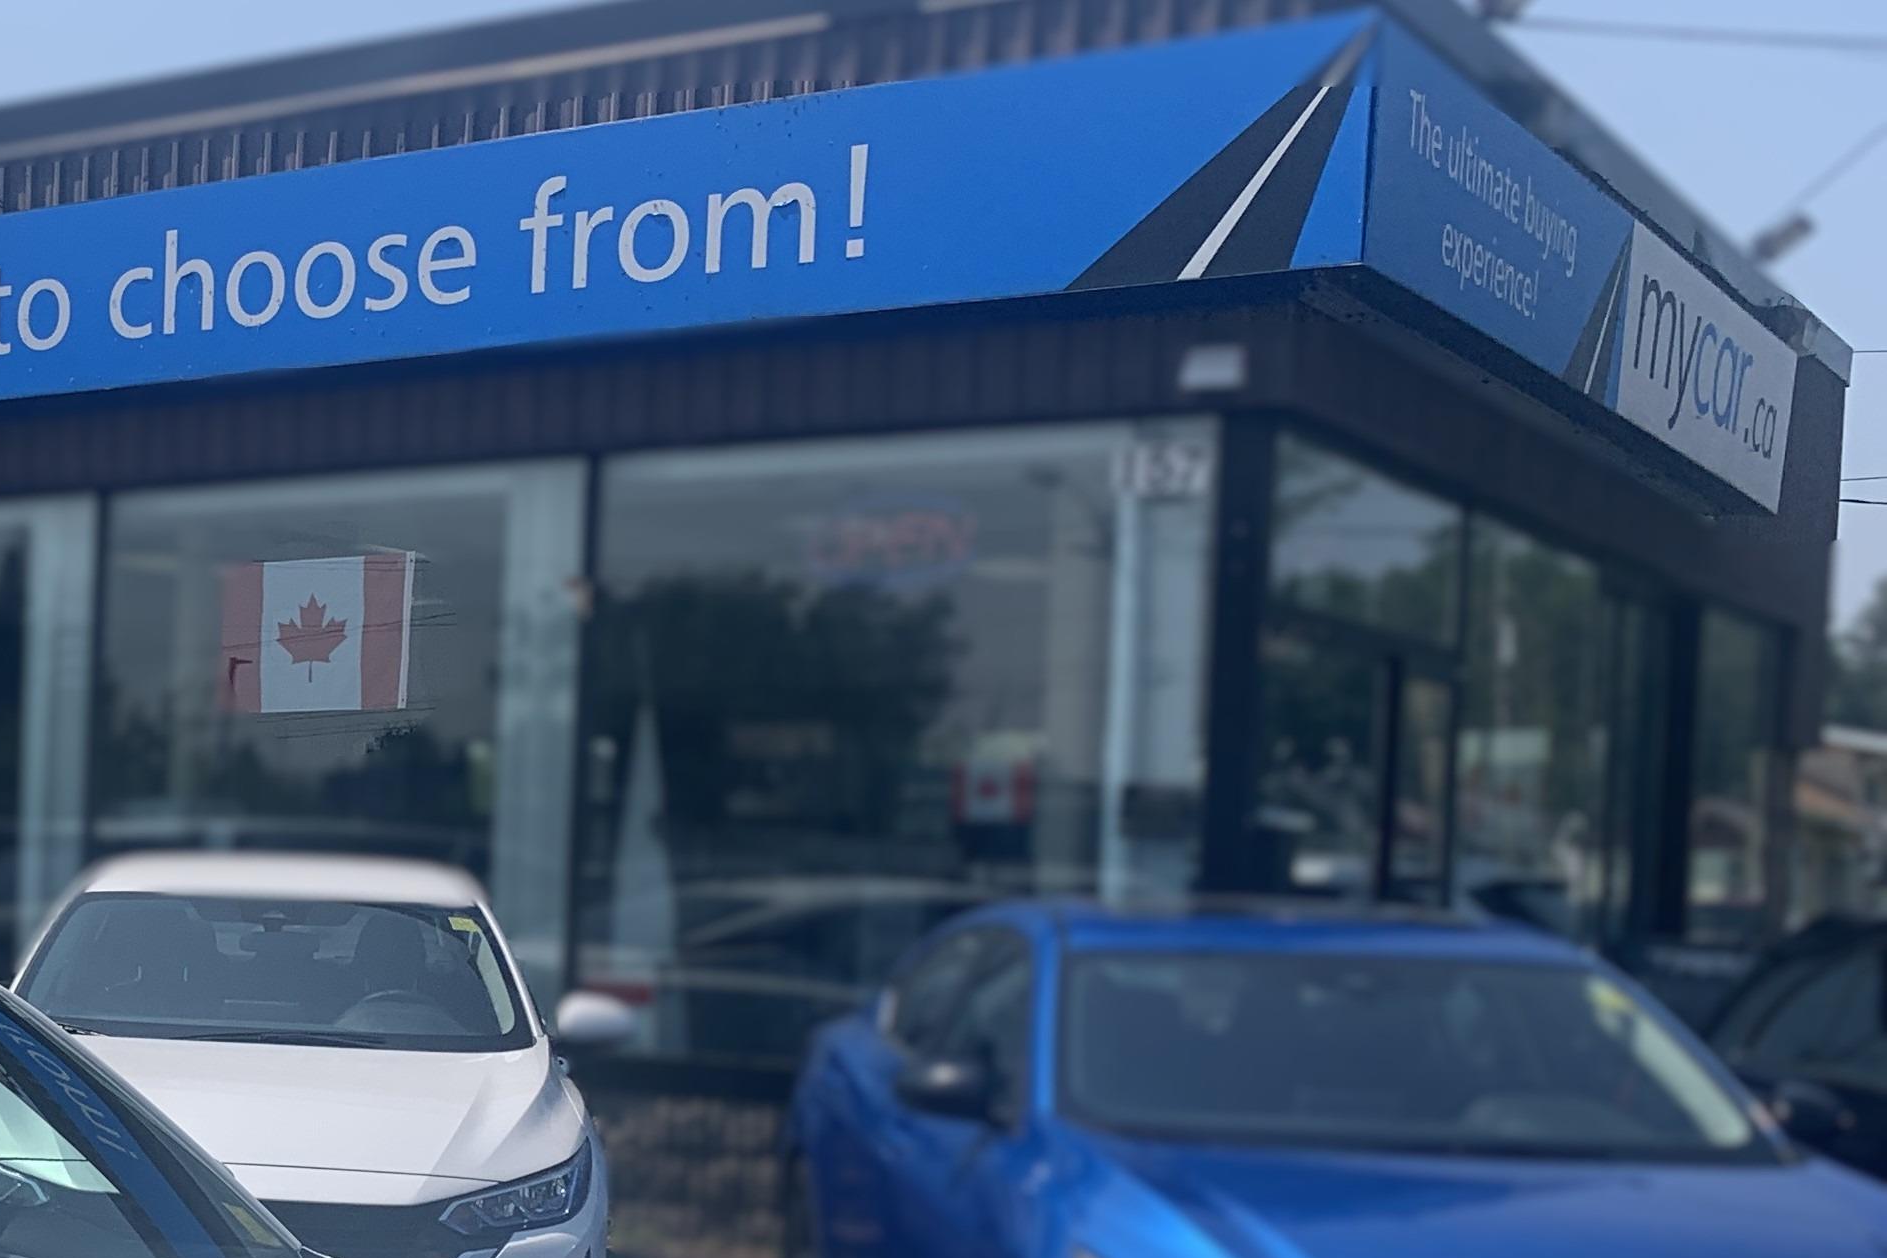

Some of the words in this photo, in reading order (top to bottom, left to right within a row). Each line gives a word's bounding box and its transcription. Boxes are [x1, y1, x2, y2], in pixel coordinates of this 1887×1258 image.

[109, 230, 477, 336] choose
[520, 144, 869, 295] from!
[1410, 89, 1443, 168] The
[1447, 127, 1521, 224] ultimate
[1525, 177, 1578, 277] buying
[1441, 223, 1538, 320] experience!
